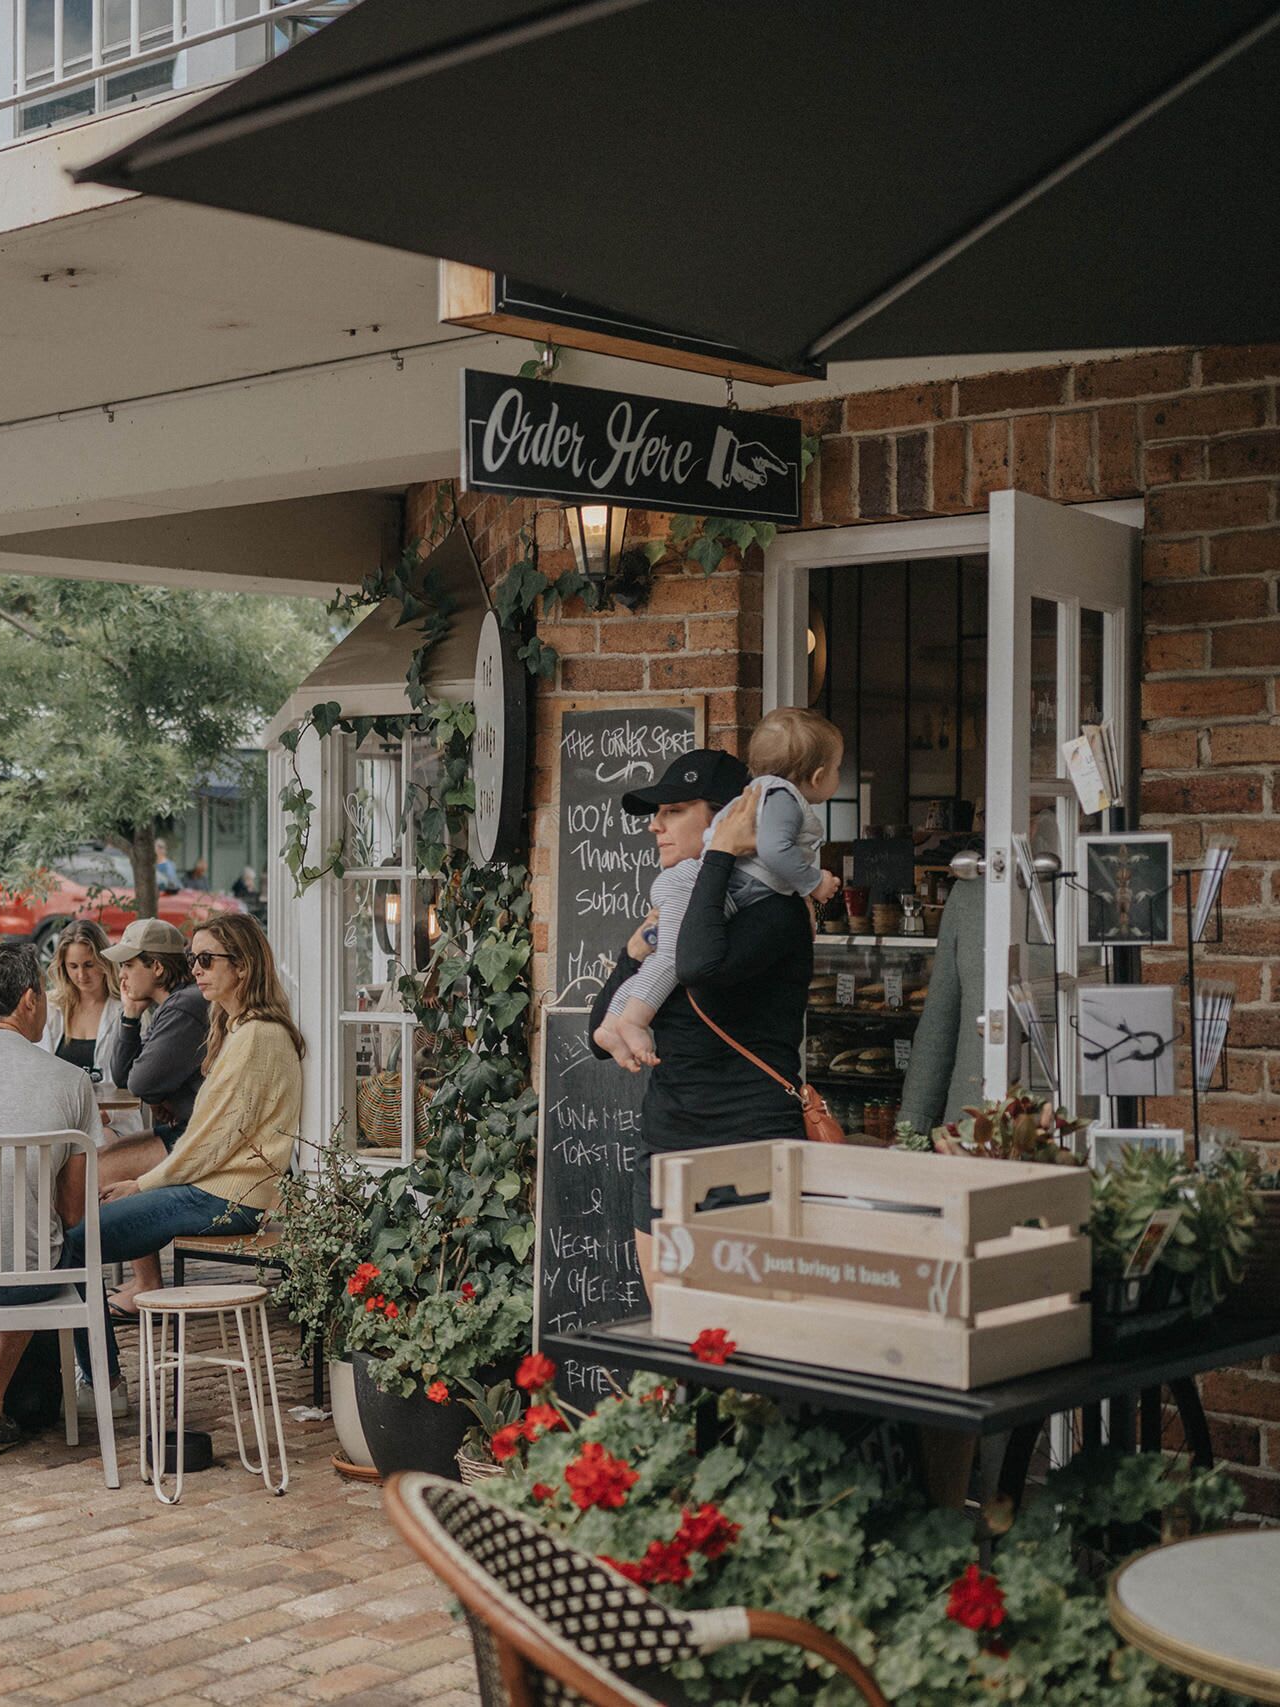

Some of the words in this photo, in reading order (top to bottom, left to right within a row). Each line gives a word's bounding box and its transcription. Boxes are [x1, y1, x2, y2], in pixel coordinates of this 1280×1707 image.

[482, 388, 588, 478] Order
[588, 401, 703, 489] Here
[560, 728, 594, 760] THE
[600, 719, 648, 757] CORNER
[648, 725, 696, 755] STORE
[568, 798, 614, 838] 100%
[549, 1095, 599, 1131] TUNA
[712, 1239, 763, 1283] OK
[763, 1252, 795, 1274] just
[797, 1255, 840, 1282] bring
[843, 1261, 858, 1281] it
[860, 1266, 902, 1288] back
